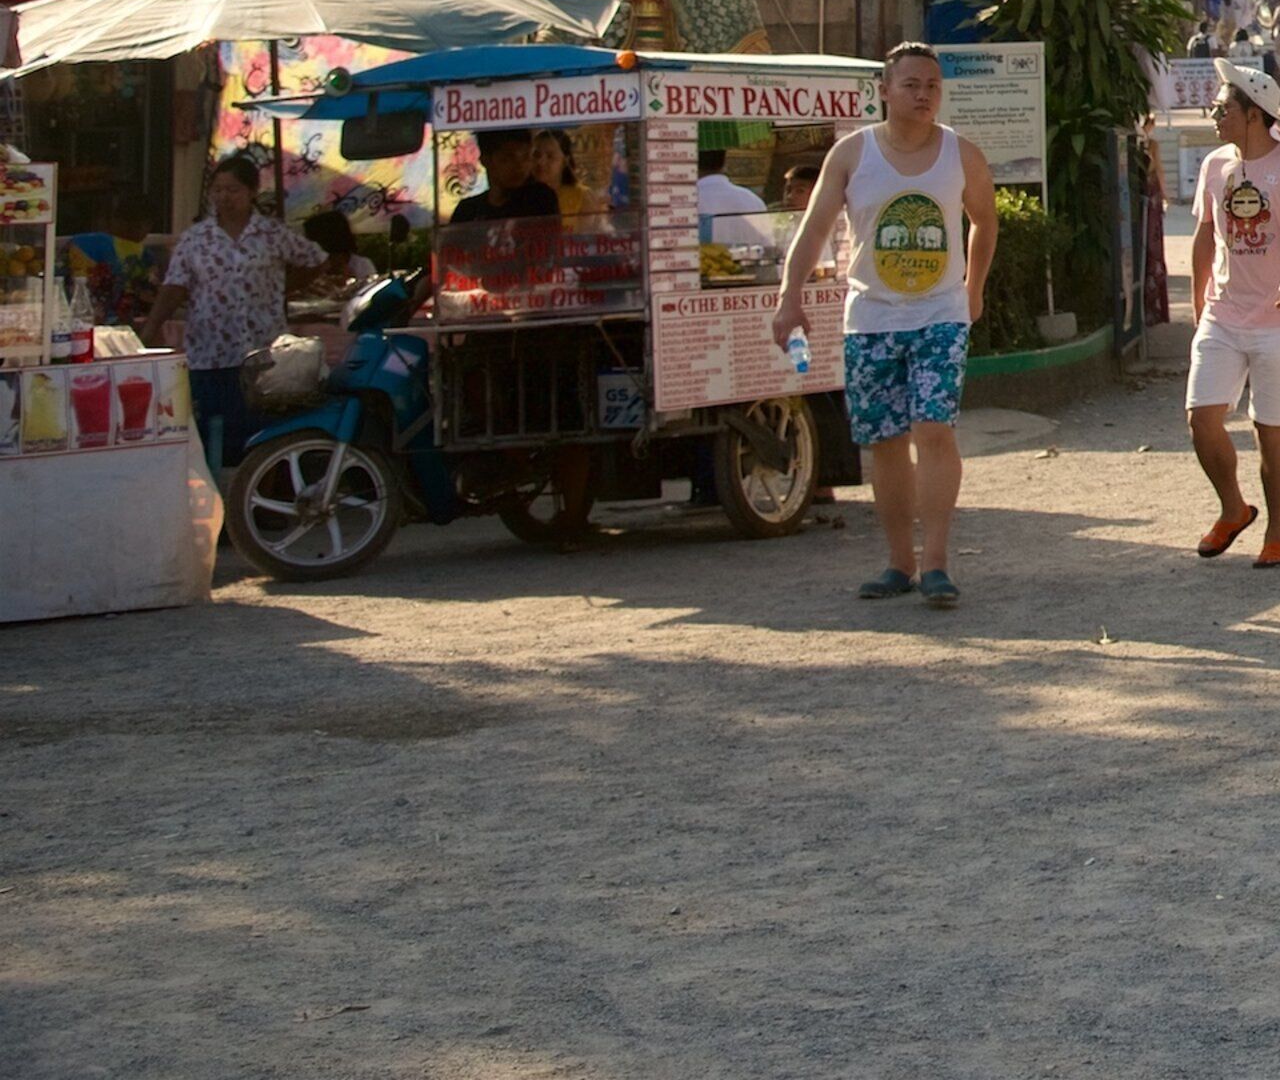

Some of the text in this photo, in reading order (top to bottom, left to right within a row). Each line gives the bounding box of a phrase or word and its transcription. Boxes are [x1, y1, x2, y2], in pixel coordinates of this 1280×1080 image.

[945, 52, 1003, 64] Operating
[953, 66, 995, 76] Drones
[446, 77, 628, 121] Banana Pancake
[664, 83, 863, 119] BEST PANCAKE
[554, 238, 589, 256] The
[596, 234, 634, 255] Best
[469, 287, 606, 312] Make to Order
[688, 297, 719, 314] THE
[723, 294, 756, 312] BEST
[607, 388, 629, 402] GS
